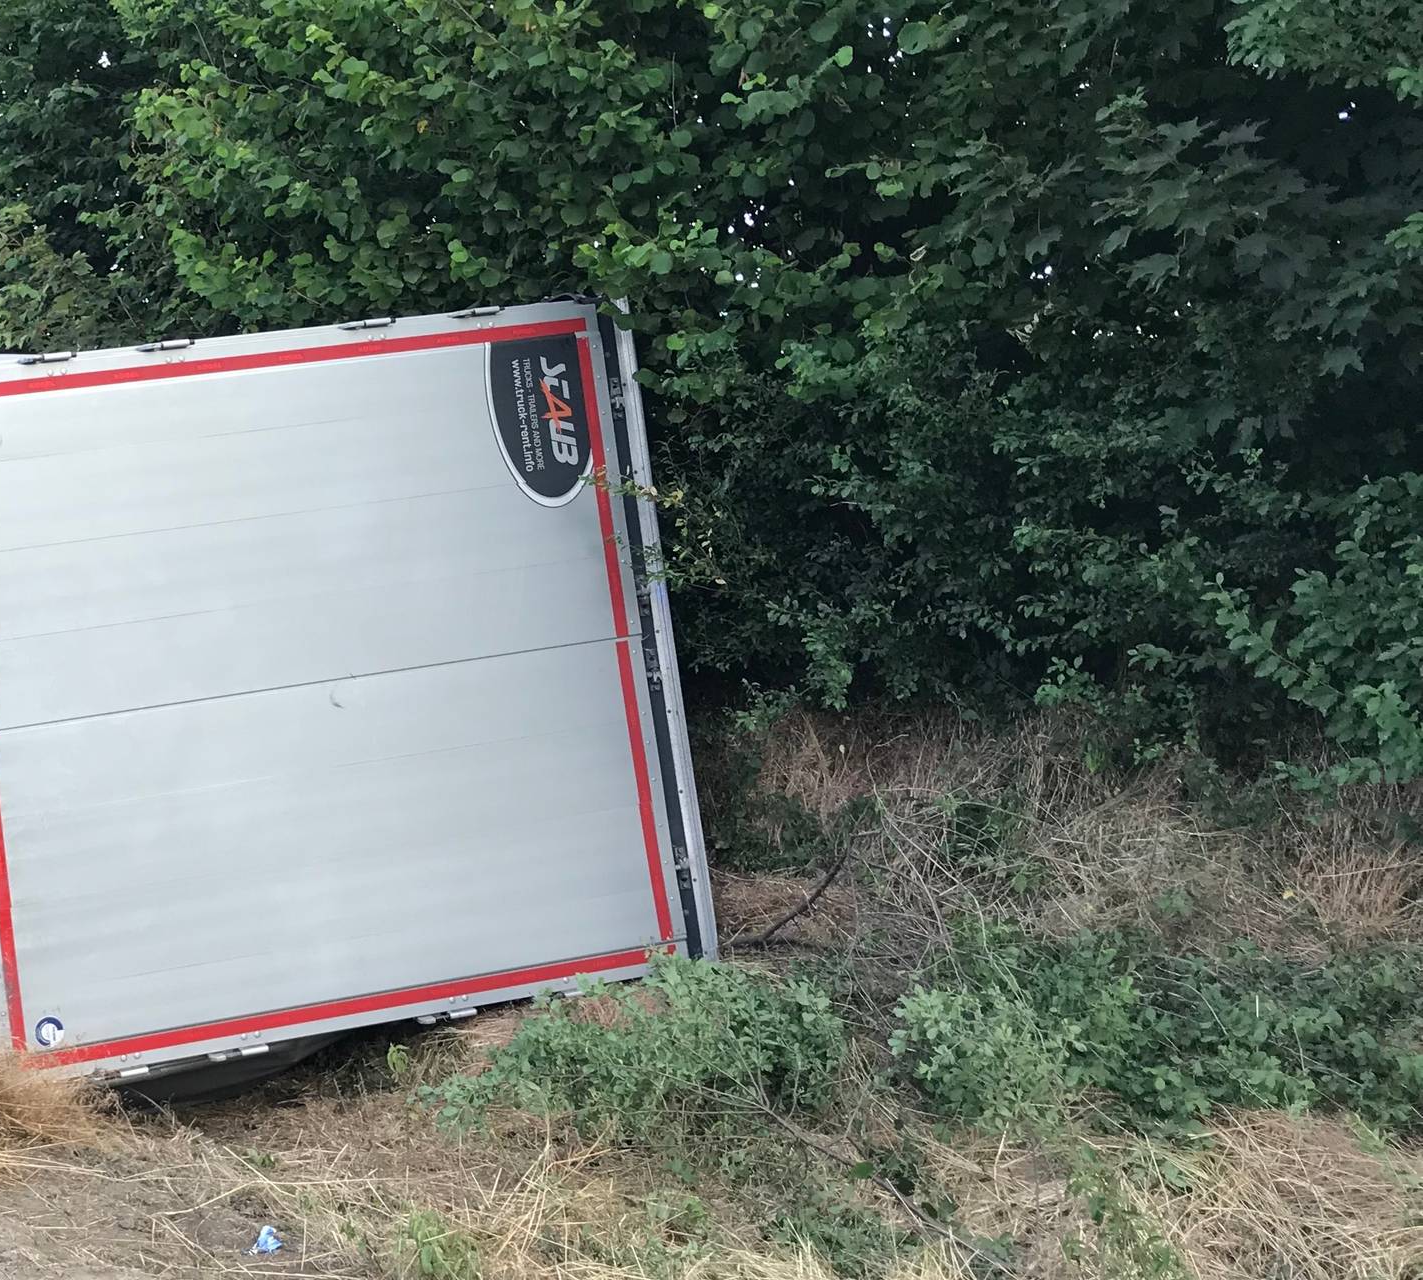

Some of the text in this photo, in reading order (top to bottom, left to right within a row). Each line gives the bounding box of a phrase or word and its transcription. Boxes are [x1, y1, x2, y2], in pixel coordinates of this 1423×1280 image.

[522, 358, 534, 388] TRUCKS
[511, 359, 535, 473] www.truck-rent.info
[527, 394, 539, 430] TRAILERS
[532, 430, 542, 447] AND
[535, 448, 545, 472] MORE
